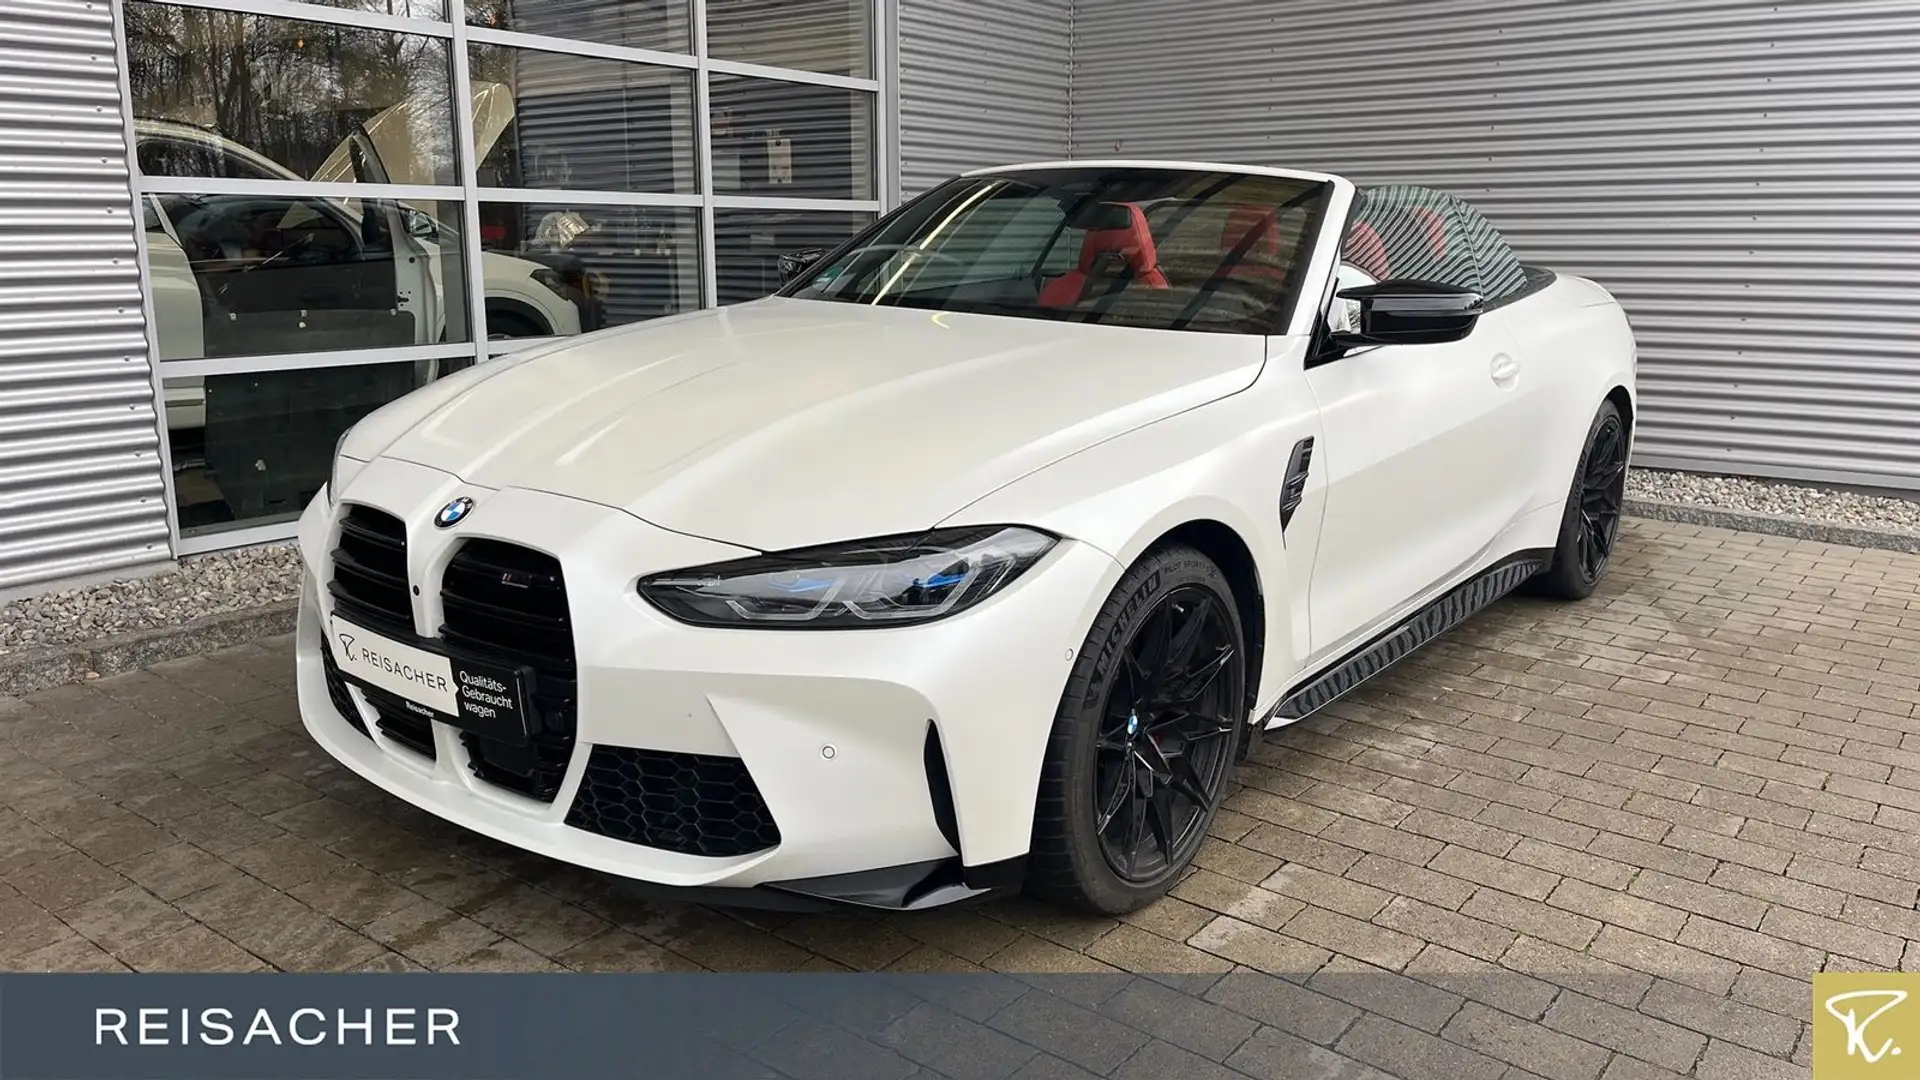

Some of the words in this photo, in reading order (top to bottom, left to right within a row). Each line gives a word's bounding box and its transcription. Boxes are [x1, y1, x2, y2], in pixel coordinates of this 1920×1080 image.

[1096, 571, 1160, 675] MICHELIN
[361, 647, 448, 693] REISACHER
[459, 670, 507, 692] Qualitäts-
[462, 684, 513, 709] Gebraucht
[405, 700, 435, 718] Reisacher
[464, 701, 497, 719] wagen
